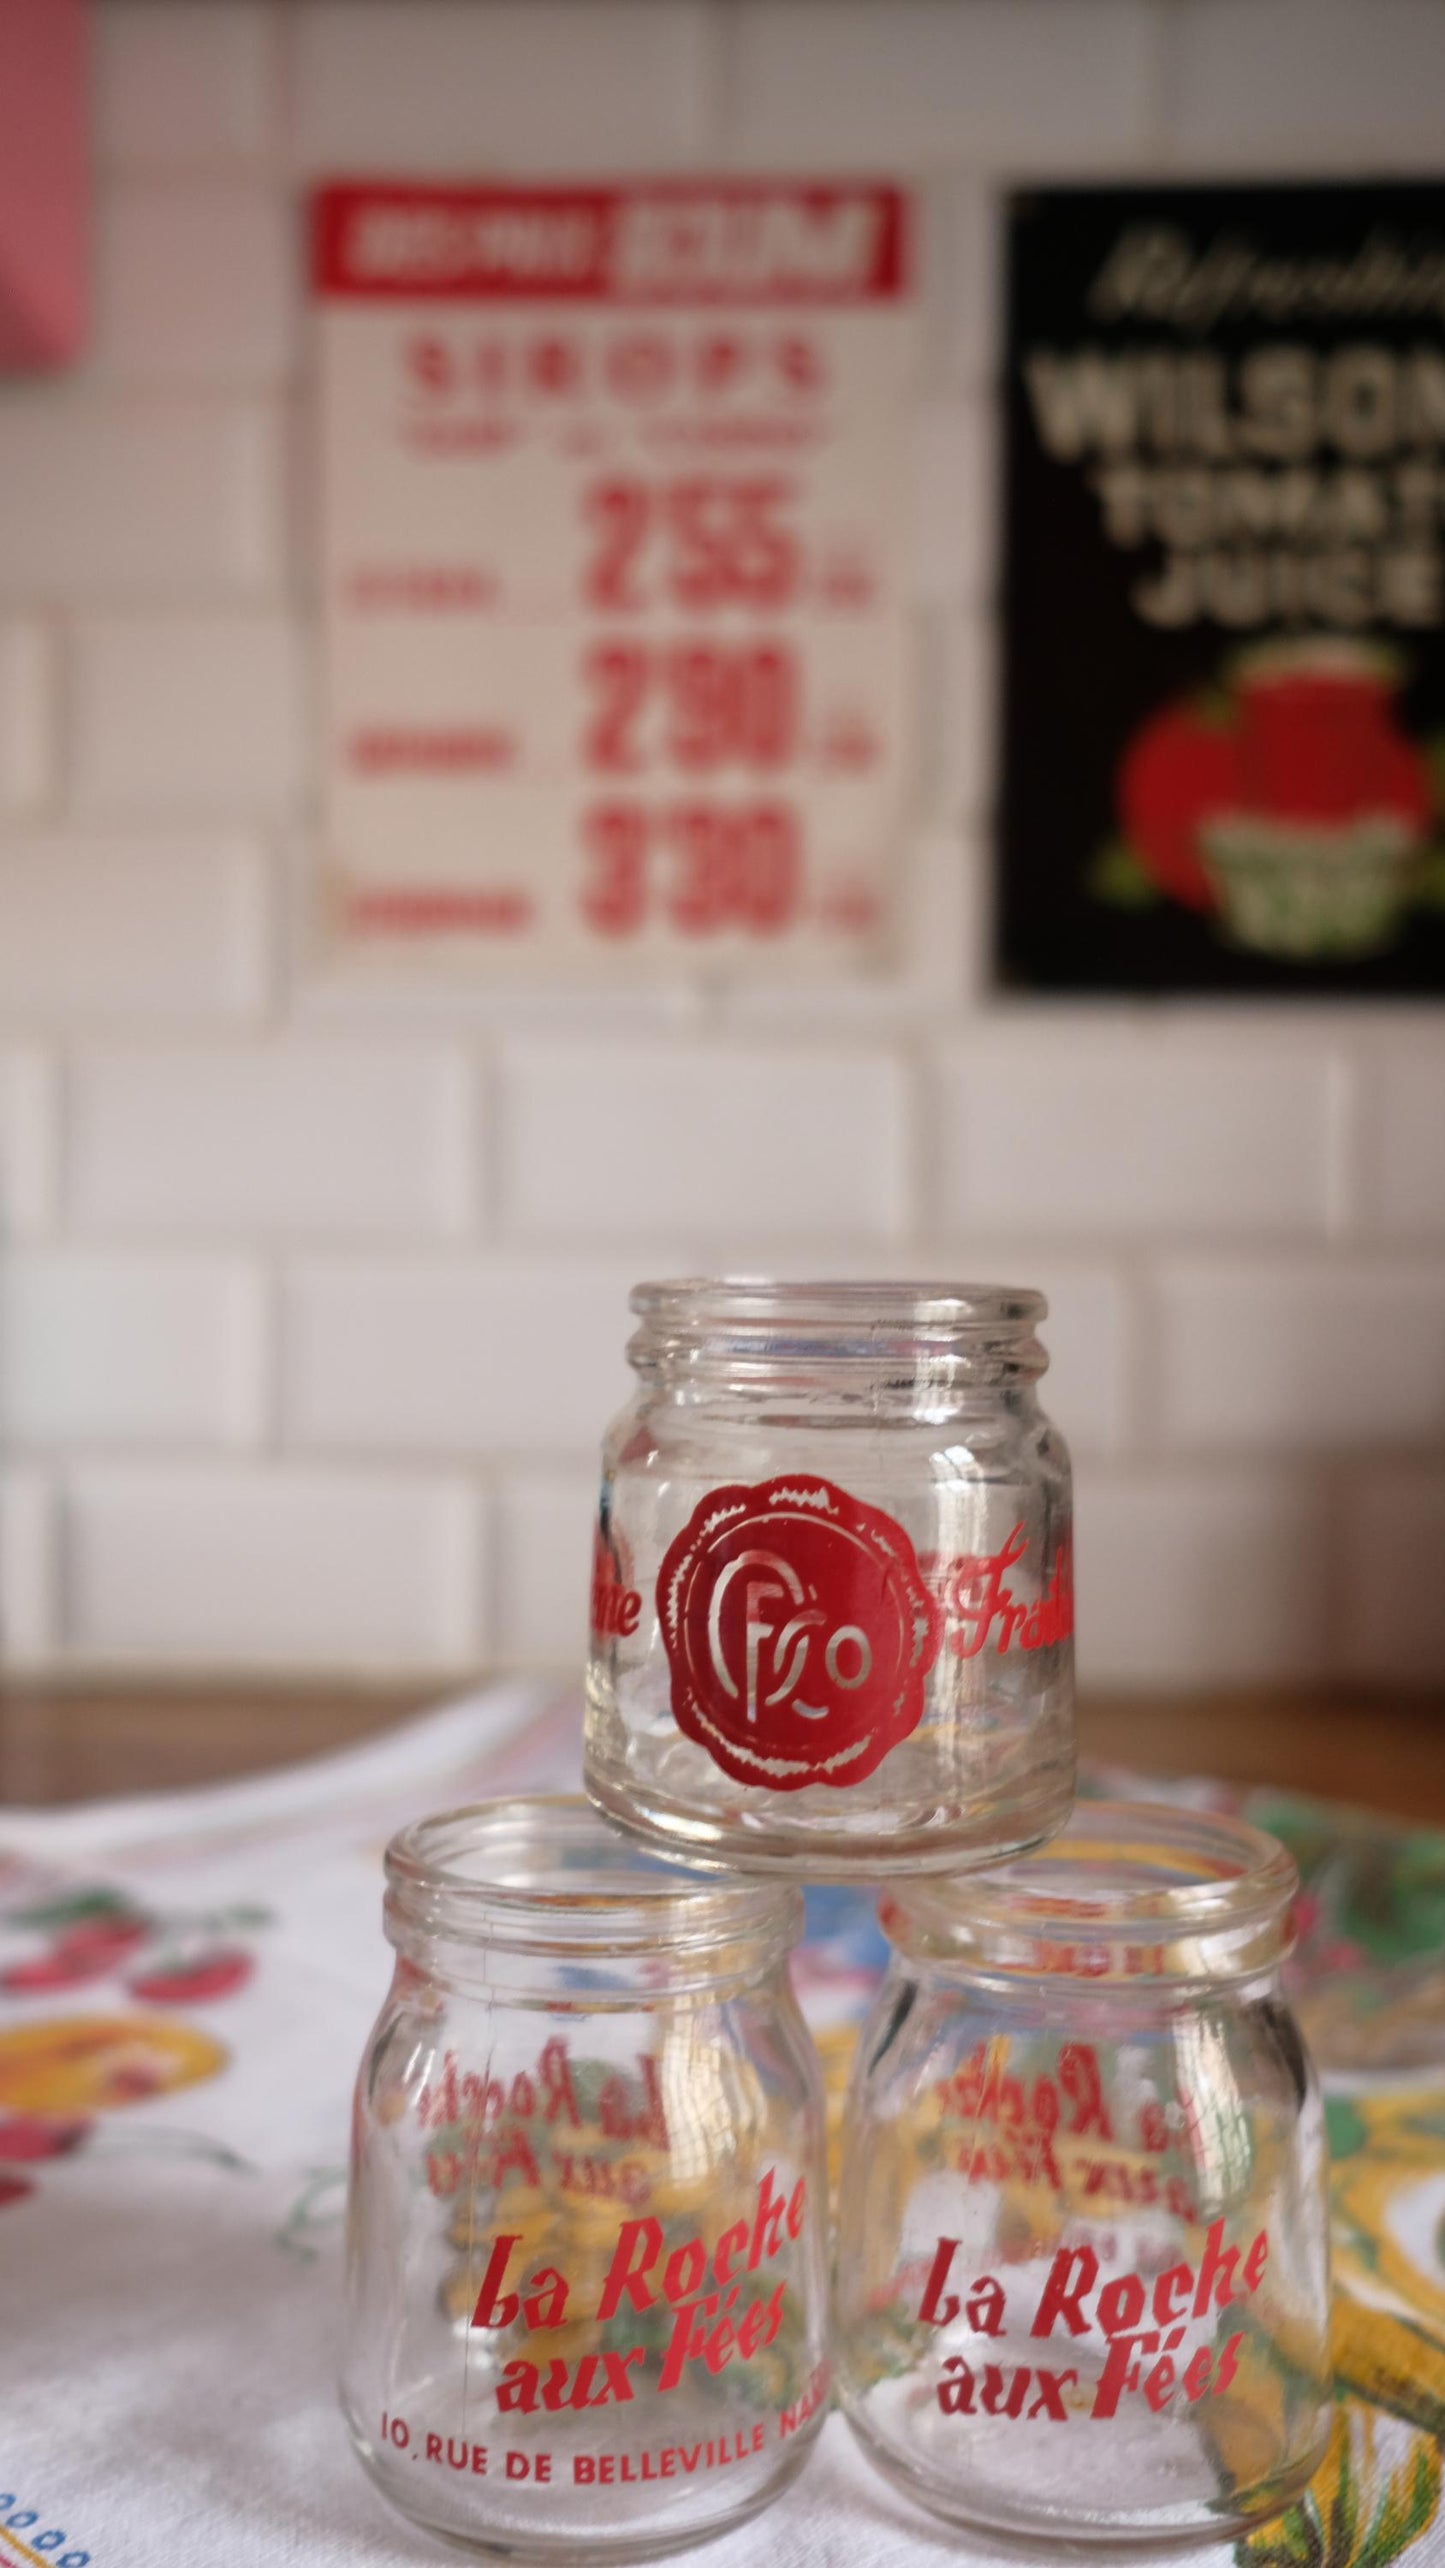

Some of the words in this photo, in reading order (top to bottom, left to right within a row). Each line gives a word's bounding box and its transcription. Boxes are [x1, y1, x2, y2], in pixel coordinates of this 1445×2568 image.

[404, 330, 826, 402] SIROPS
[1136, 548, 1445, 624] JUICE
[471, 2234, 570, 2331] La
[596, 2166, 806, 2322] Roche
[918, 2237, 1007, 2338] La
[1030, 2216, 1268, 2339] Roche
[495, 2346, 646, 2415] aux
[657, 2280, 787, 2393] Fées
[936, 2355, 1079, 2422] aux
[1090, 2326, 1245, 2420] Fées
[426, 2432, 488, 2476] RUE
[506, 2450, 552, 2483] DE
[573, 2423, 764, 2486] BELLEVILLE
